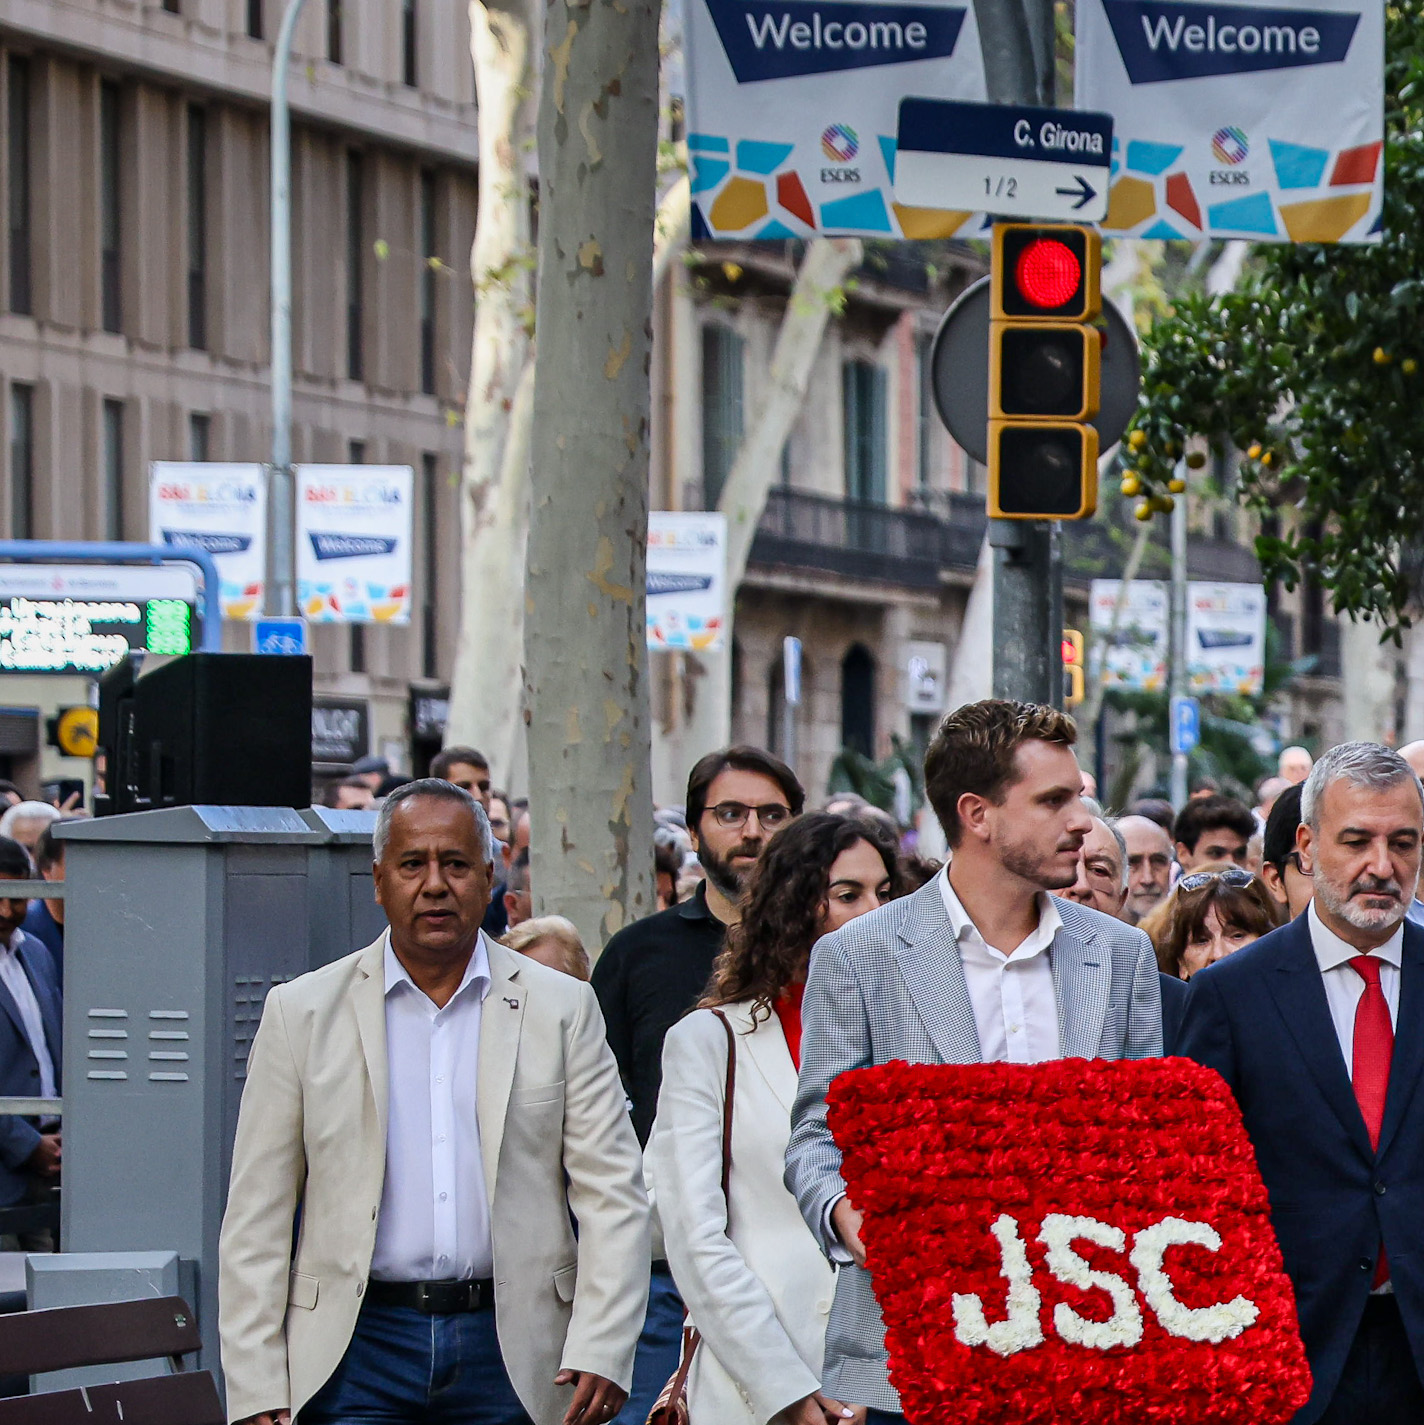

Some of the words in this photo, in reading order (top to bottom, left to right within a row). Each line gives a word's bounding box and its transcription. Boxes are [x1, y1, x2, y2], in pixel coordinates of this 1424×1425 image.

[745, 12, 928, 49] Welcome
[1141, 14, 1321, 53] Welcome
[1014, 119, 1035, 147] C.
[1040, 122, 1104, 155] Girona
[820, 167, 861, 184] ESCRS
[1208, 170, 1250, 186] ESCRS
[951, 1212, 1261, 1358] JSC
